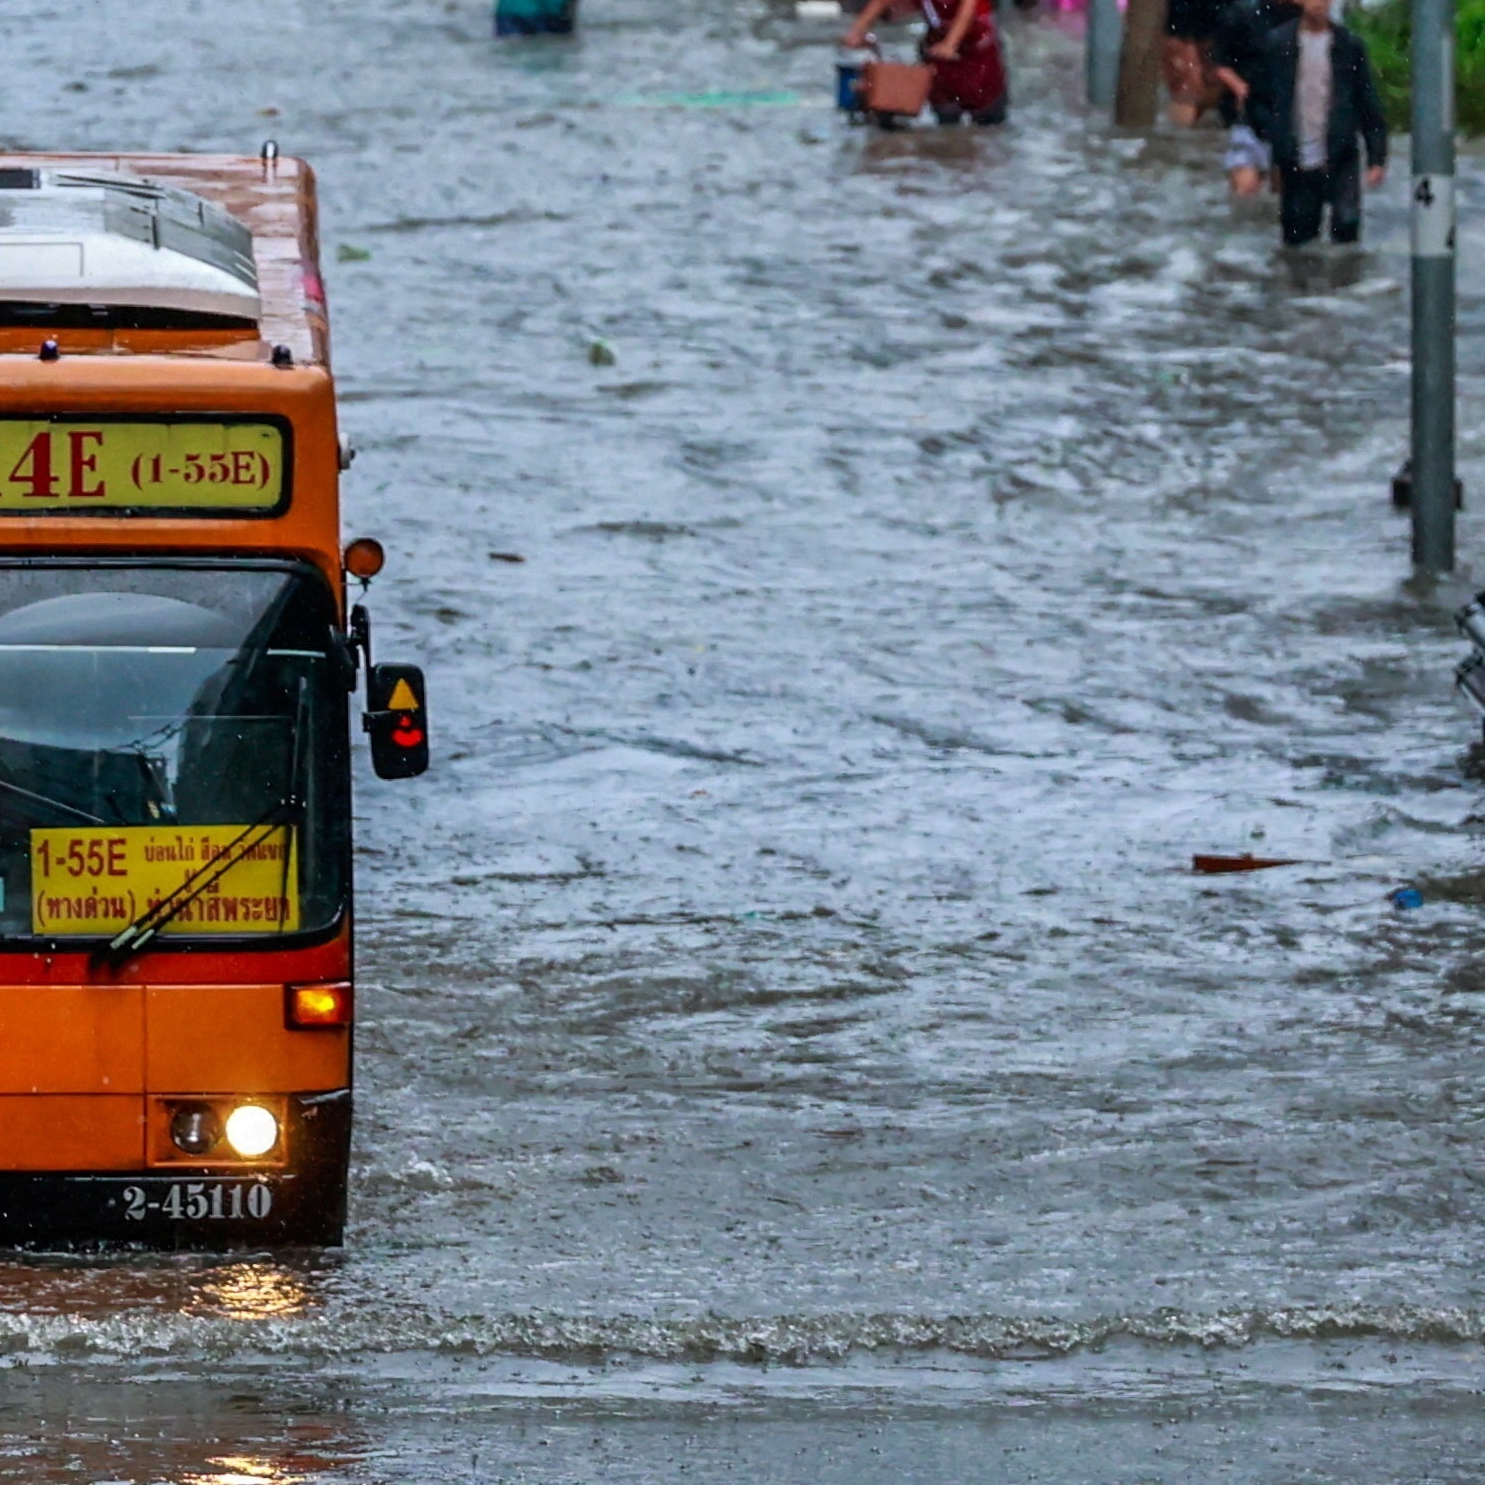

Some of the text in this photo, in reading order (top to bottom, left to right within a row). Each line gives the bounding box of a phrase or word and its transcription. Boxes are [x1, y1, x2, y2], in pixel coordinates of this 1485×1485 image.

[130, 450, 271, 491] (1-55E)
[37, 838, 128, 877] 1-55E
[37, 886, 136, 927] (ทางด่วน)
[123, 1182, 273, 1221] 2-45110
